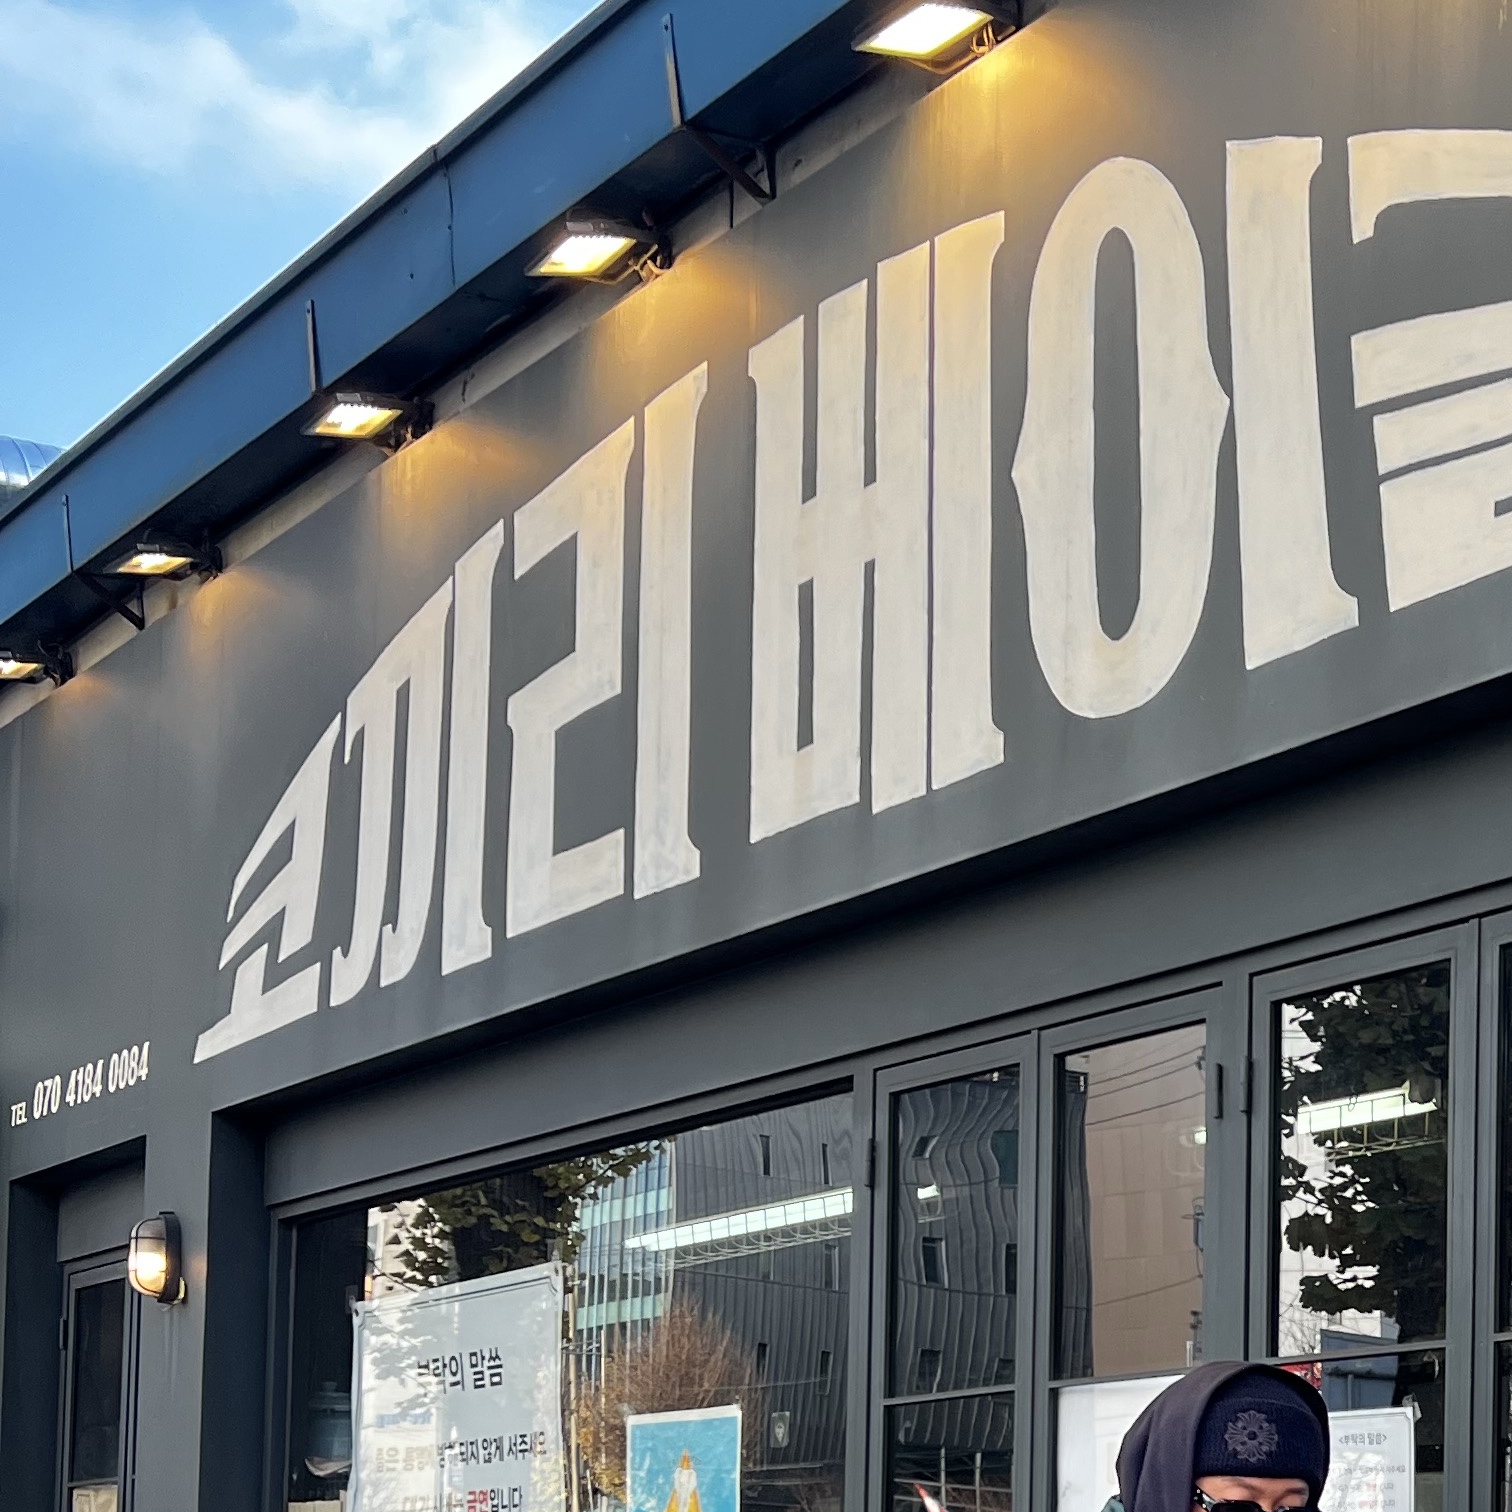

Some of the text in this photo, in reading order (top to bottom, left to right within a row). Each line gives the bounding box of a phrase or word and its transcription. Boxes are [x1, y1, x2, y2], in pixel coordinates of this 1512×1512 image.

[194, 361, 709, 1064] 코끼리
[10, 1041, 150, 1127] TEL 070 4184 0084
[469, 1347, 503, 1390] 말씀
[482, 1435, 504, 1464] 않게
